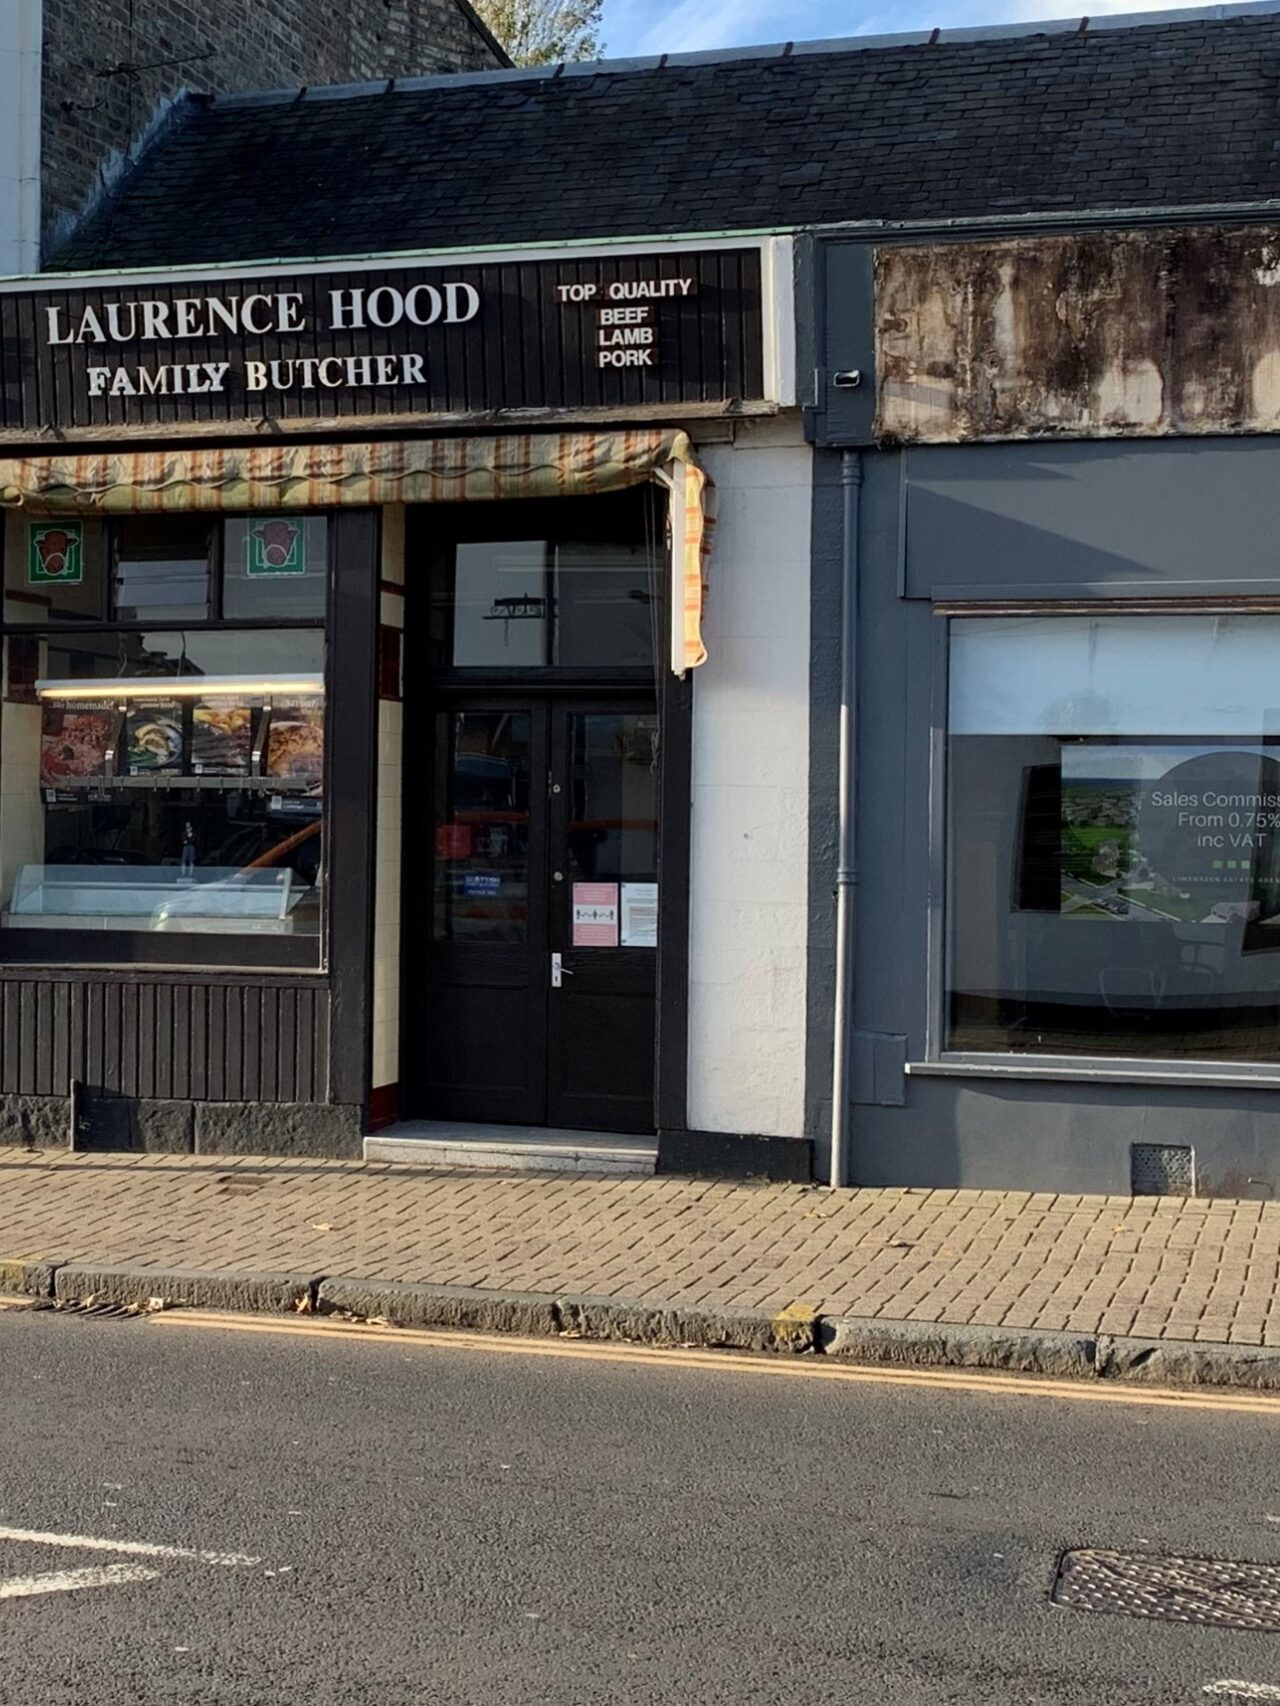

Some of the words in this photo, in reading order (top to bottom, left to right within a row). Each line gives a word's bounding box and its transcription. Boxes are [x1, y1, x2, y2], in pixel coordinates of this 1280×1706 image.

[557, 283, 597, 302] TOP
[608, 278, 693, 300] QUALITY
[44, 292, 306, 346] LAURENCE
[328, 281, 481, 331] HOOD
[599, 306, 649, 326] BEEF
[598, 327, 654, 346] LAMB
[598, 349, 653, 368] PORK
[86, 361, 231, 398] FAMILY
[246, 353, 428, 391] BUTCHER
[1151, 791, 1199, 807] Sales
[1178, 812, 1223, 827] From
[1228, 812, 1280, 828] 0.75%
[1198, 834, 1224, 847] inc
[1228, 833, 1267, 848] VAT
